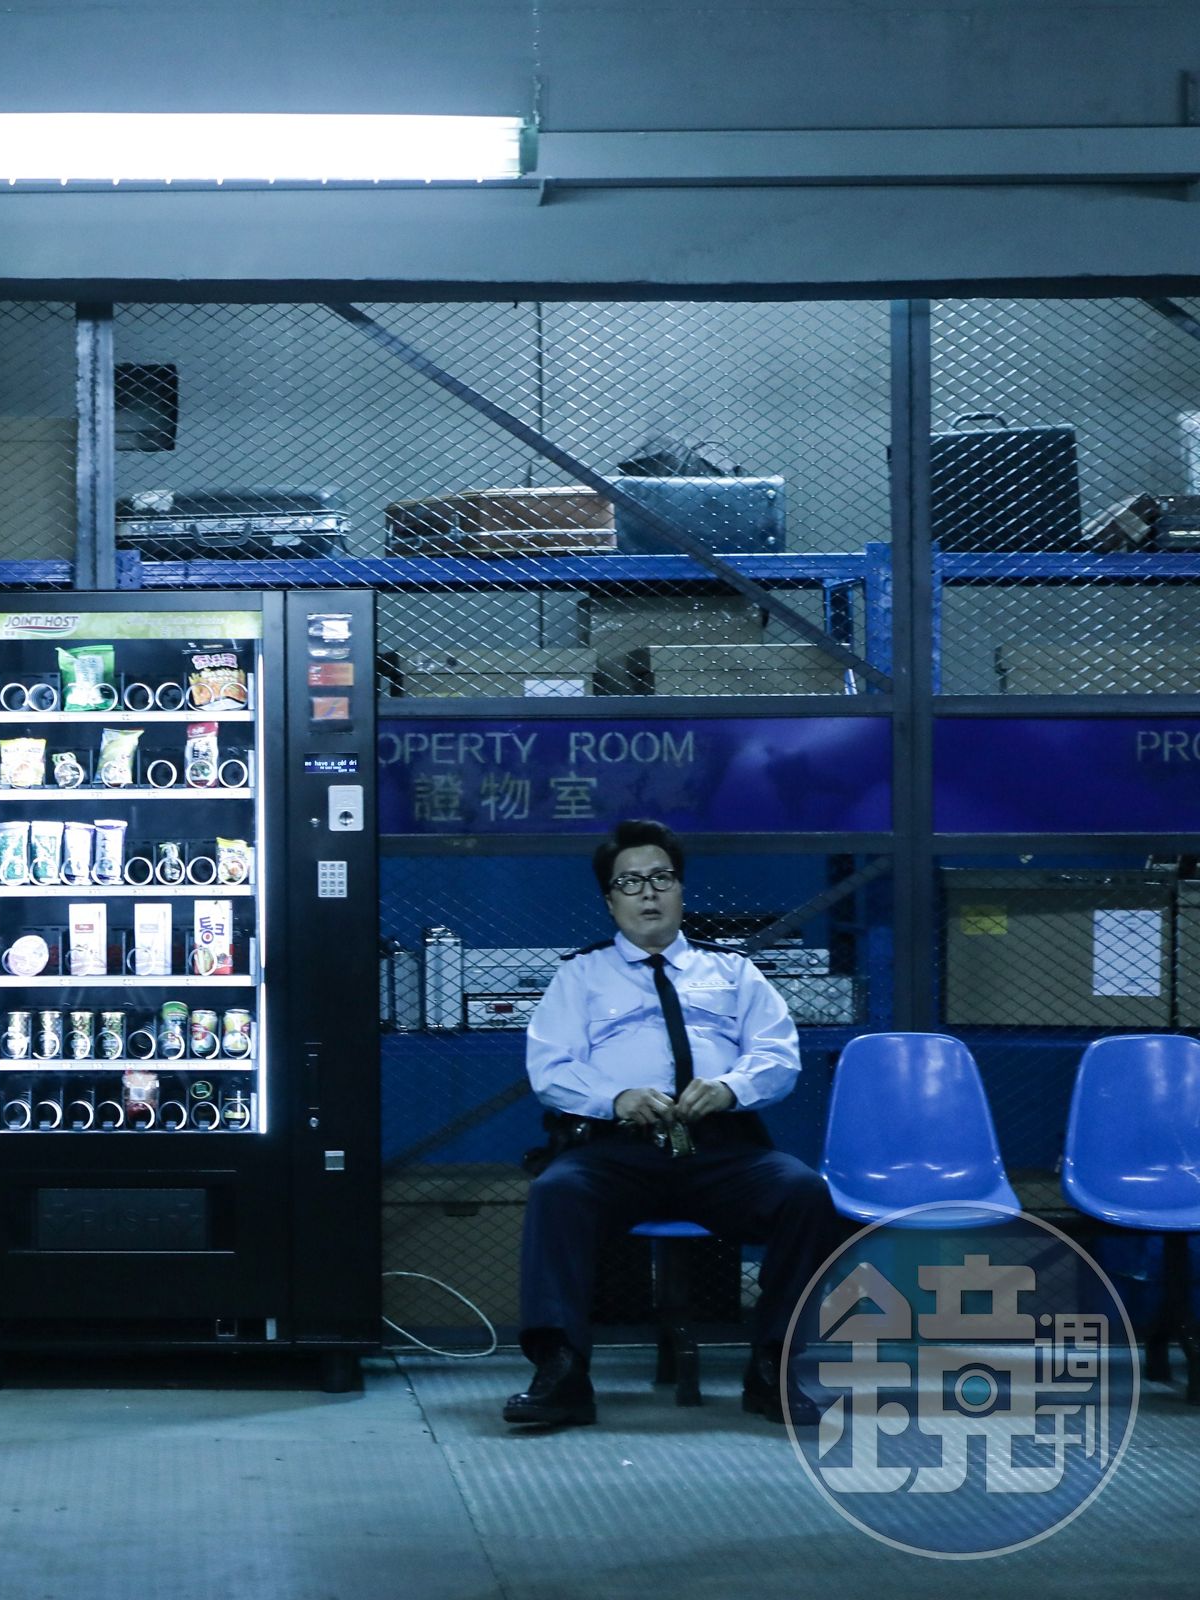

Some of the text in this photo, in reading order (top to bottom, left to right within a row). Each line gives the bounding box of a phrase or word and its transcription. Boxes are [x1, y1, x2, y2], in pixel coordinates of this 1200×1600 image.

[4, 615, 79, 627] JOINT HOST
[569, 731, 695, 764] ROOM
[1136, 730, 1200, 763] PR
[413, 771, 598, 822] 證物室
[81, 1208, 162, 1233] PUSH
